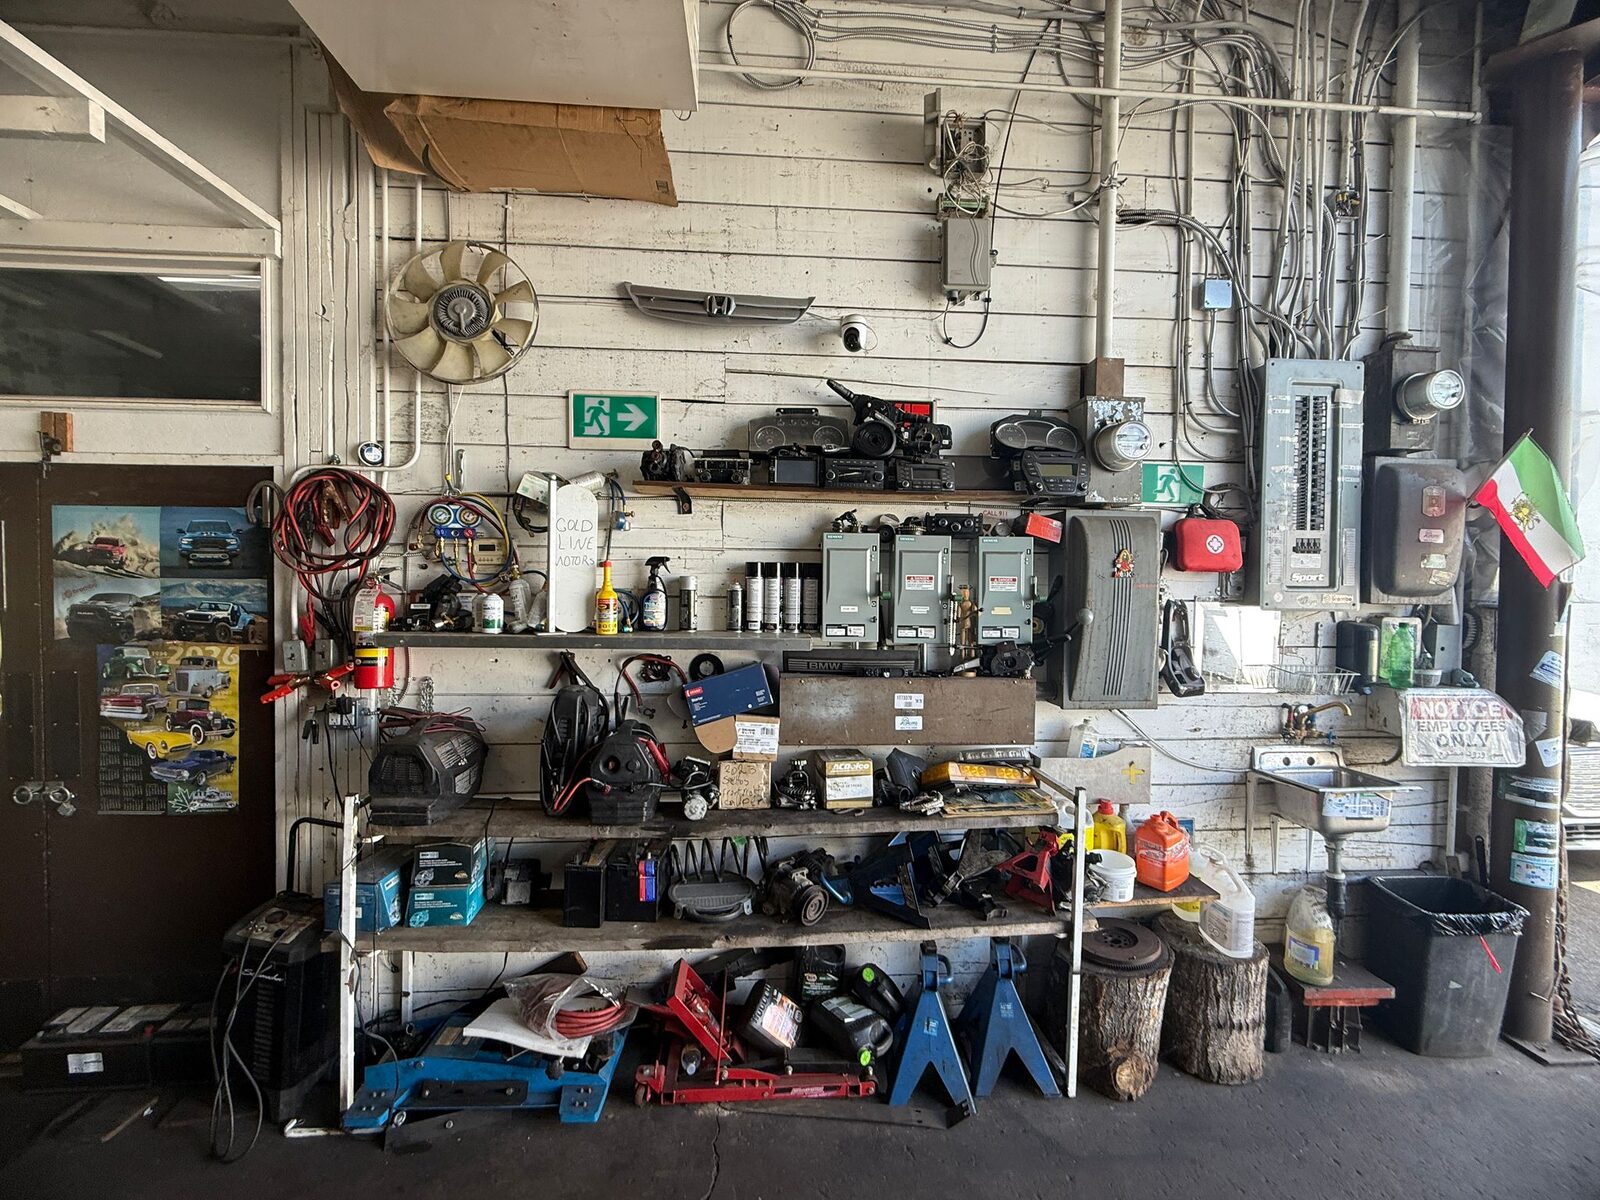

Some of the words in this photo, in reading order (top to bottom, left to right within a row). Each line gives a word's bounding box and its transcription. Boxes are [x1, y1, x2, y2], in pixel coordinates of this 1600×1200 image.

[556, 517, 593, 532] GOLD
[558, 534, 594, 550] LINE
[1291, 573, 1325, 583] Sport
[808, 662, 841, 670] BMW
[1419, 700, 1502, 719] NOTICE
[1417, 721, 1507, 732] EMPLOYEES
[1436, 733, 1490, 748] ONLY
[832, 761, 870, 770] ACDelco
